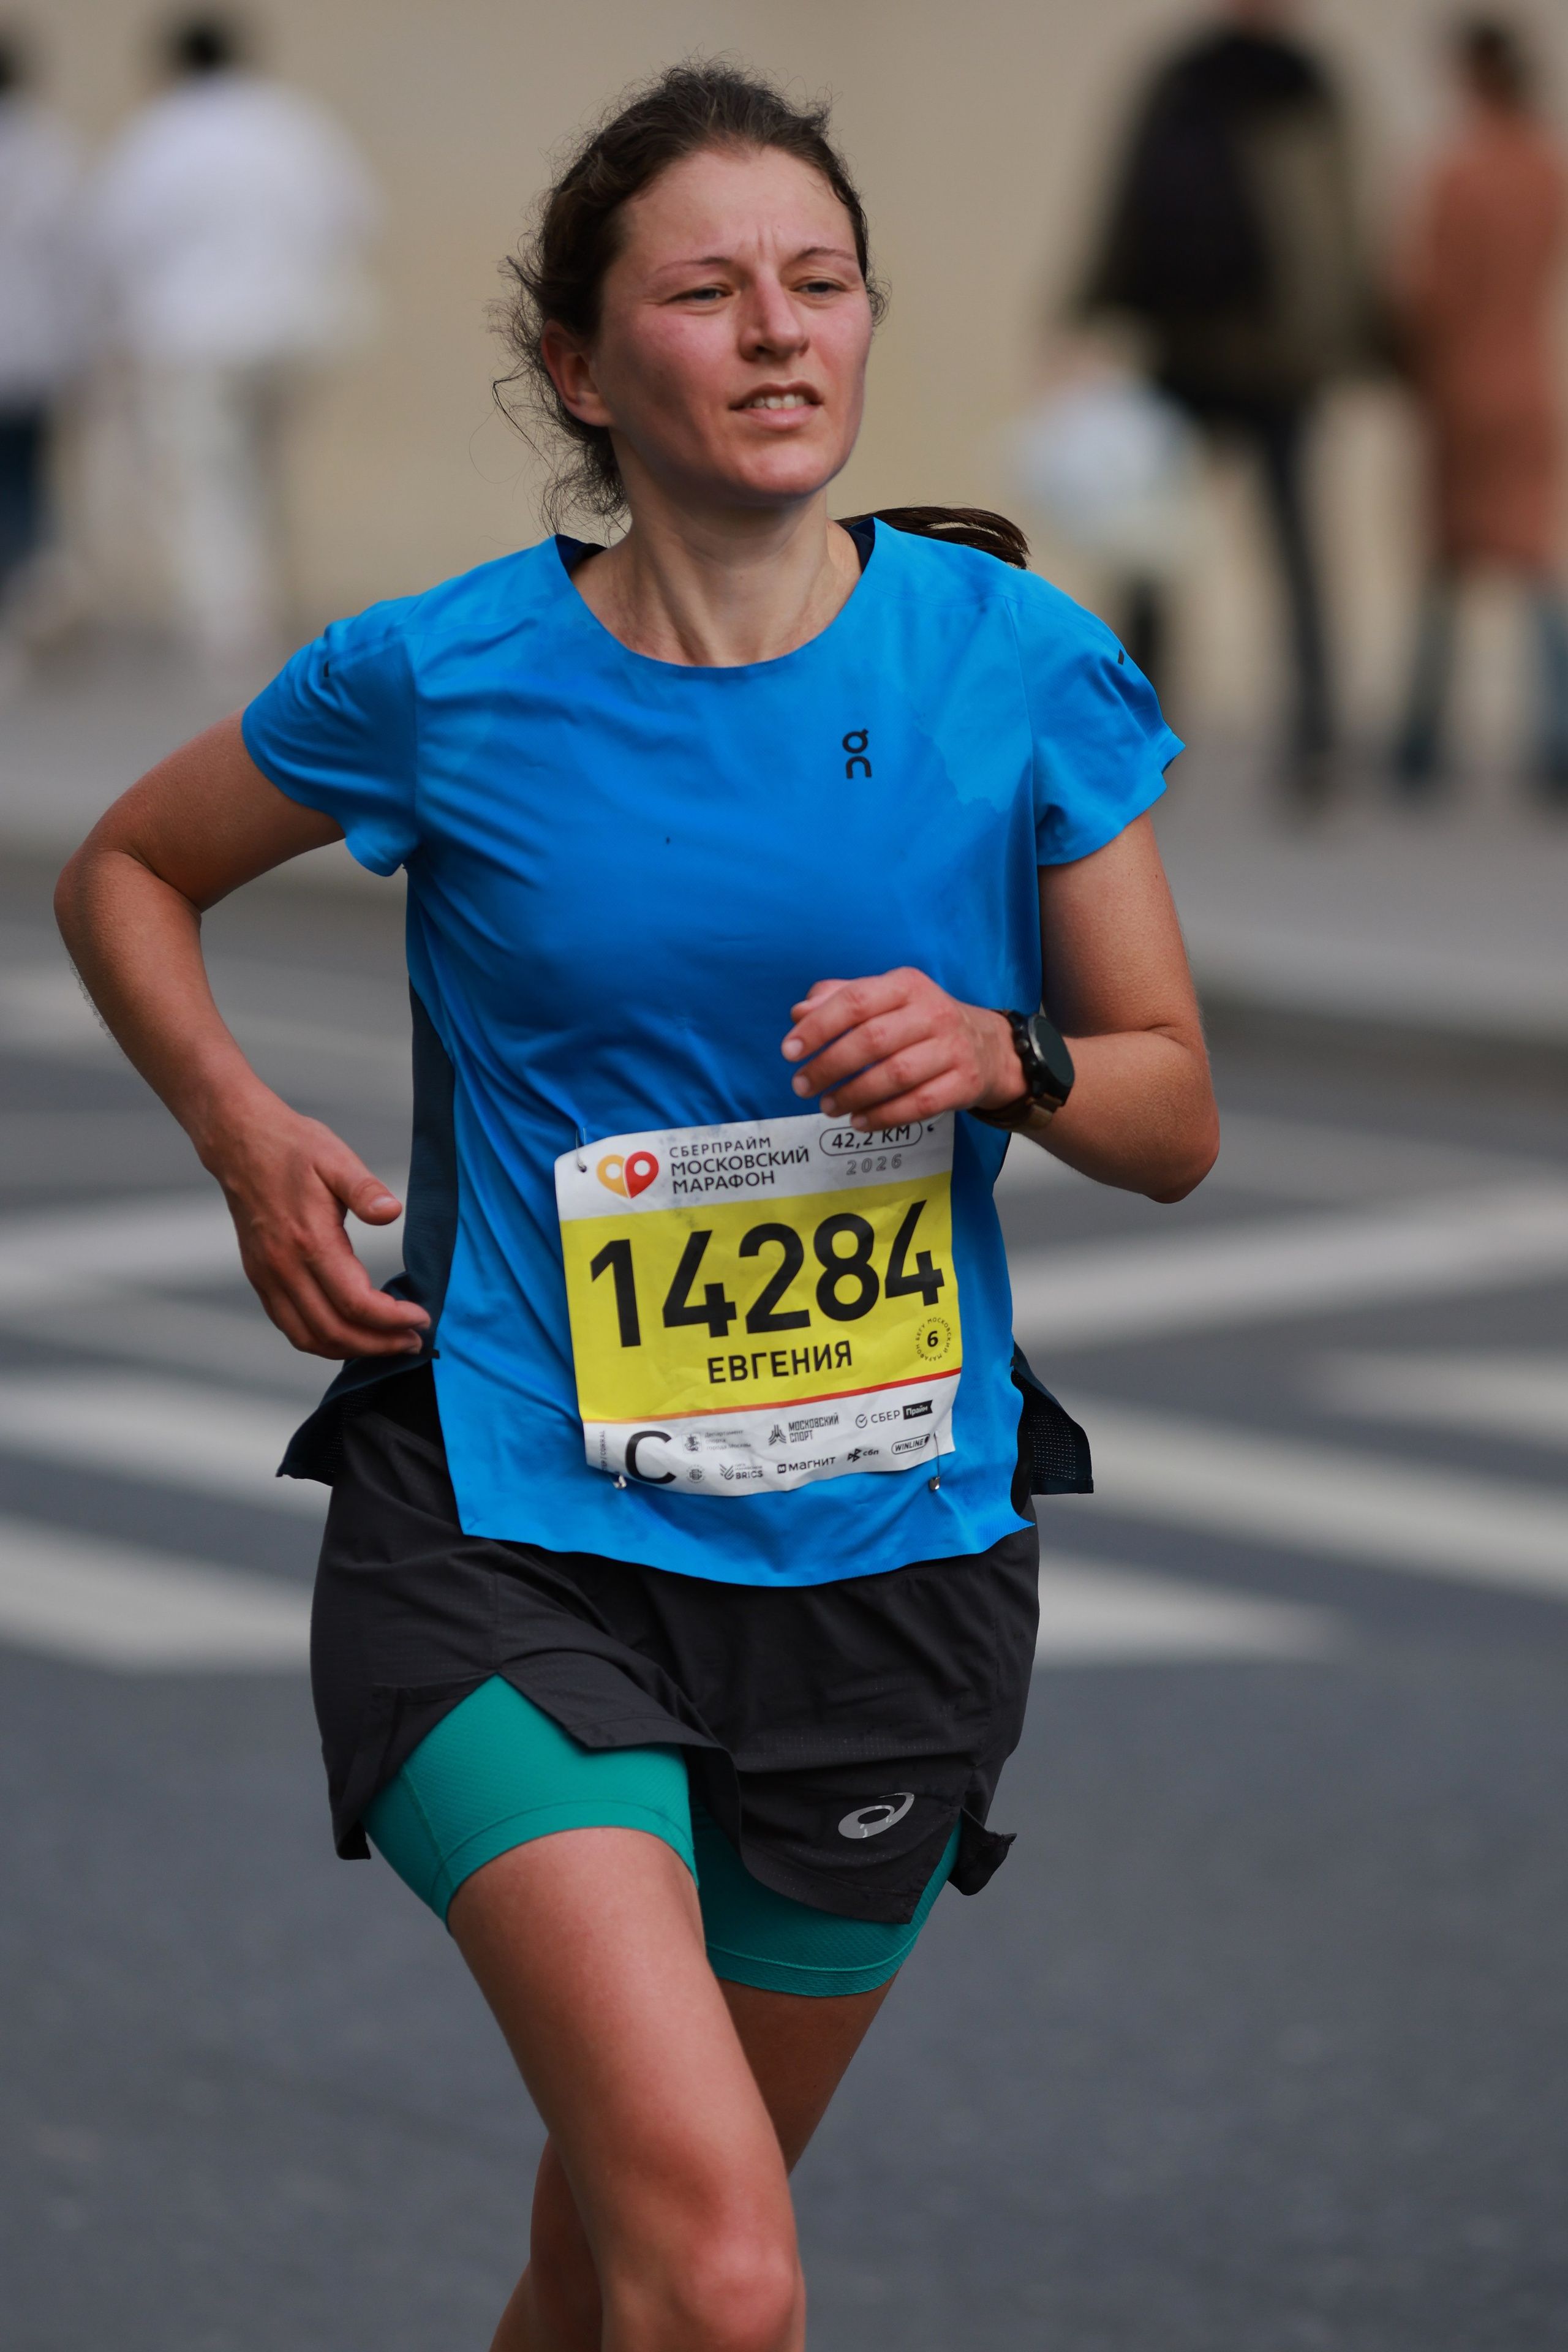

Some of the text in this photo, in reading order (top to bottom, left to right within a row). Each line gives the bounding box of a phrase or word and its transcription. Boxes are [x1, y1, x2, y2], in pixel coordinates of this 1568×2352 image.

[669, 1136, 771, 1158] СБЕРПРАЙМ
[831, 1124, 910, 1150] 42,2 КМ
[671, 1145, 810, 1177] МОСКОВСКИЙ
[845, 1153, 902, 1175] 2026
[672, 1170, 775, 1194] МАРАФОН
[590, 1199, 945, 1348] 14284
[927, 1330, 938, 1348] 6
[707, 1340, 853, 1384] ЕВГЕНИЯ
[788, 1412, 839, 1431] МОСКОВСКИЙ
[870, 1404, 929, 1423] СБЕР Прайм
[790, 1429, 813, 1444] СПОРТ
[894, 1438, 924, 1452] WINLINE
[736, 1470, 763, 1479] BRICS
